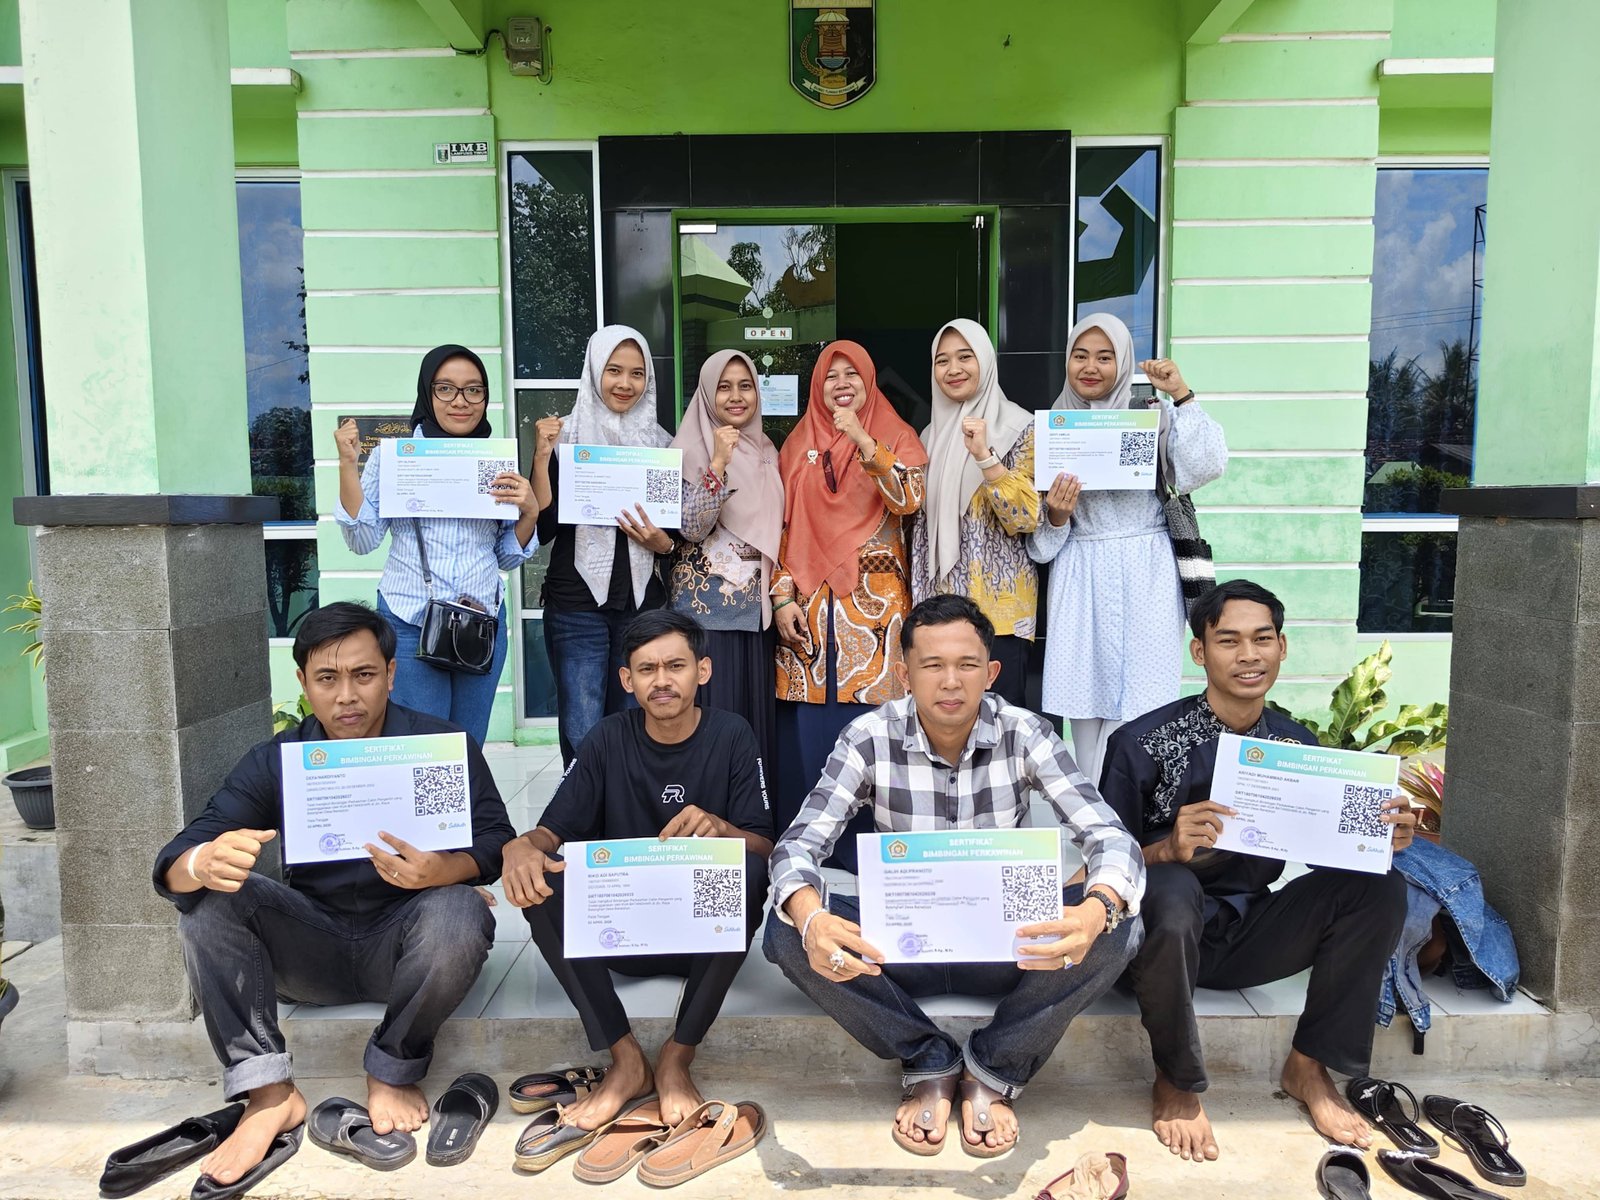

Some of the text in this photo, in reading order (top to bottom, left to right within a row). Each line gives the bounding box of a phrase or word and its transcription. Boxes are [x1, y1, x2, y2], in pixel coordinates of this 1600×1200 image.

[450, 142, 487, 152] IMB
[364, 744, 406, 753] SERTIFIKAT
[340, 752, 433, 764] BIMBINGAN PERKAWINAN
[1303, 754, 1343, 765] SERTIFIKAT
[1276, 761, 1367, 778] BIMBINGAN PERKAWINAN
[761, 790, 770, 810] YOURS
[949, 838, 993, 846] SERTIFIKAT
[923, 849, 1024, 858] BIMBINGAN PERKAWINAN
[624, 855, 665, 863] BIMBINGAN
